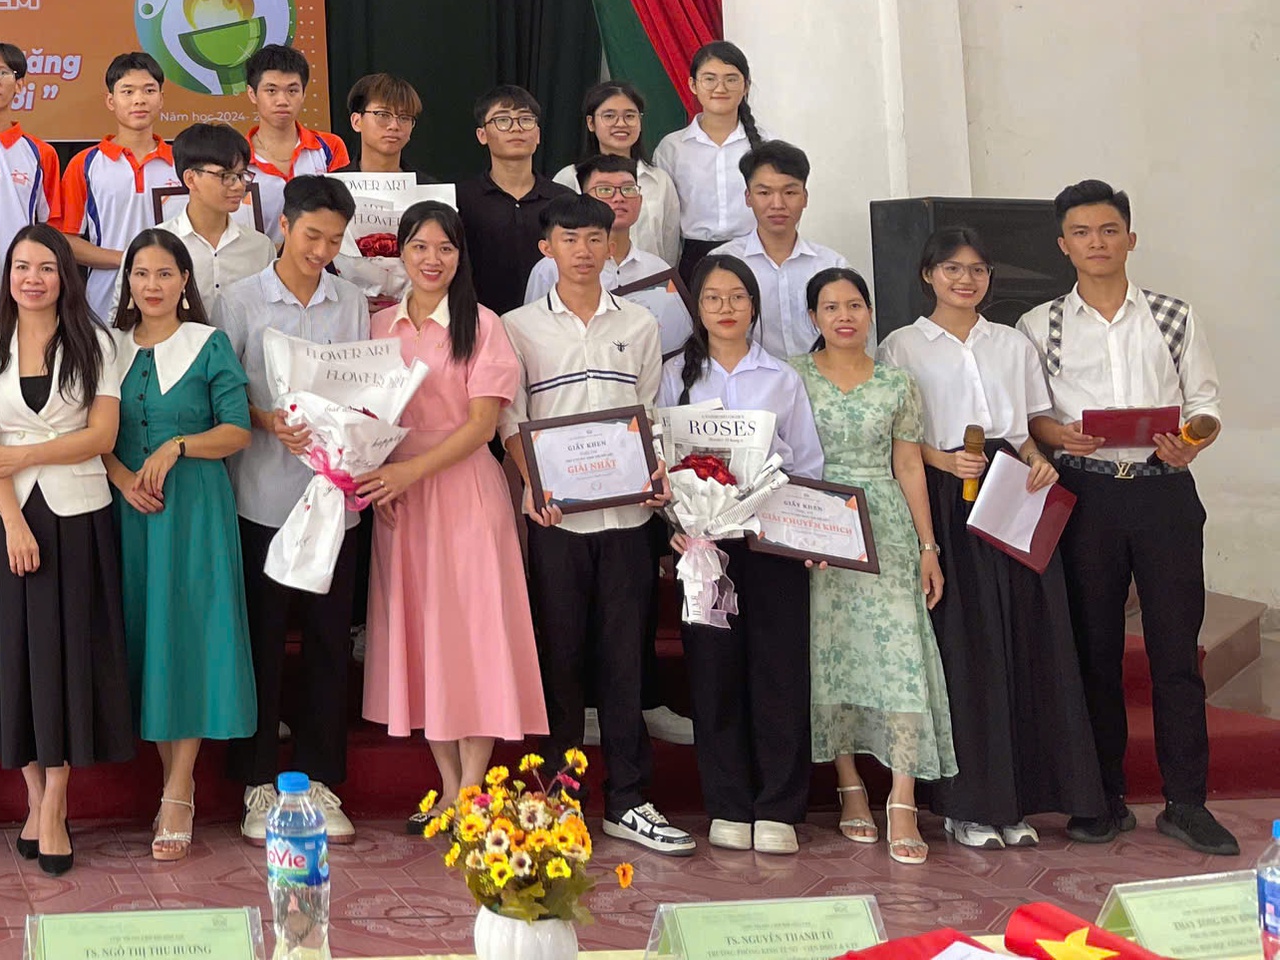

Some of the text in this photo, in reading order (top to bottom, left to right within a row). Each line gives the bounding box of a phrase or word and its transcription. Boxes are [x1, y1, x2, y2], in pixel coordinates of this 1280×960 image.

[23, 48, 82, 80] ăng
[160, 110, 188, 122] Năm
[383, 179, 408, 191] ART
[306, 343, 390, 360] FLOWER ART
[689, 419, 757, 437] ROSES
[567, 462, 588, 474] GIẢI
[590, 457, 617, 470] NHẤT
[267, 845, 306, 868] aVie
[102, 944, 125, 957] NGÔ
[127, 946, 146, 958] THỊ
[149, 945, 170, 957] THU
